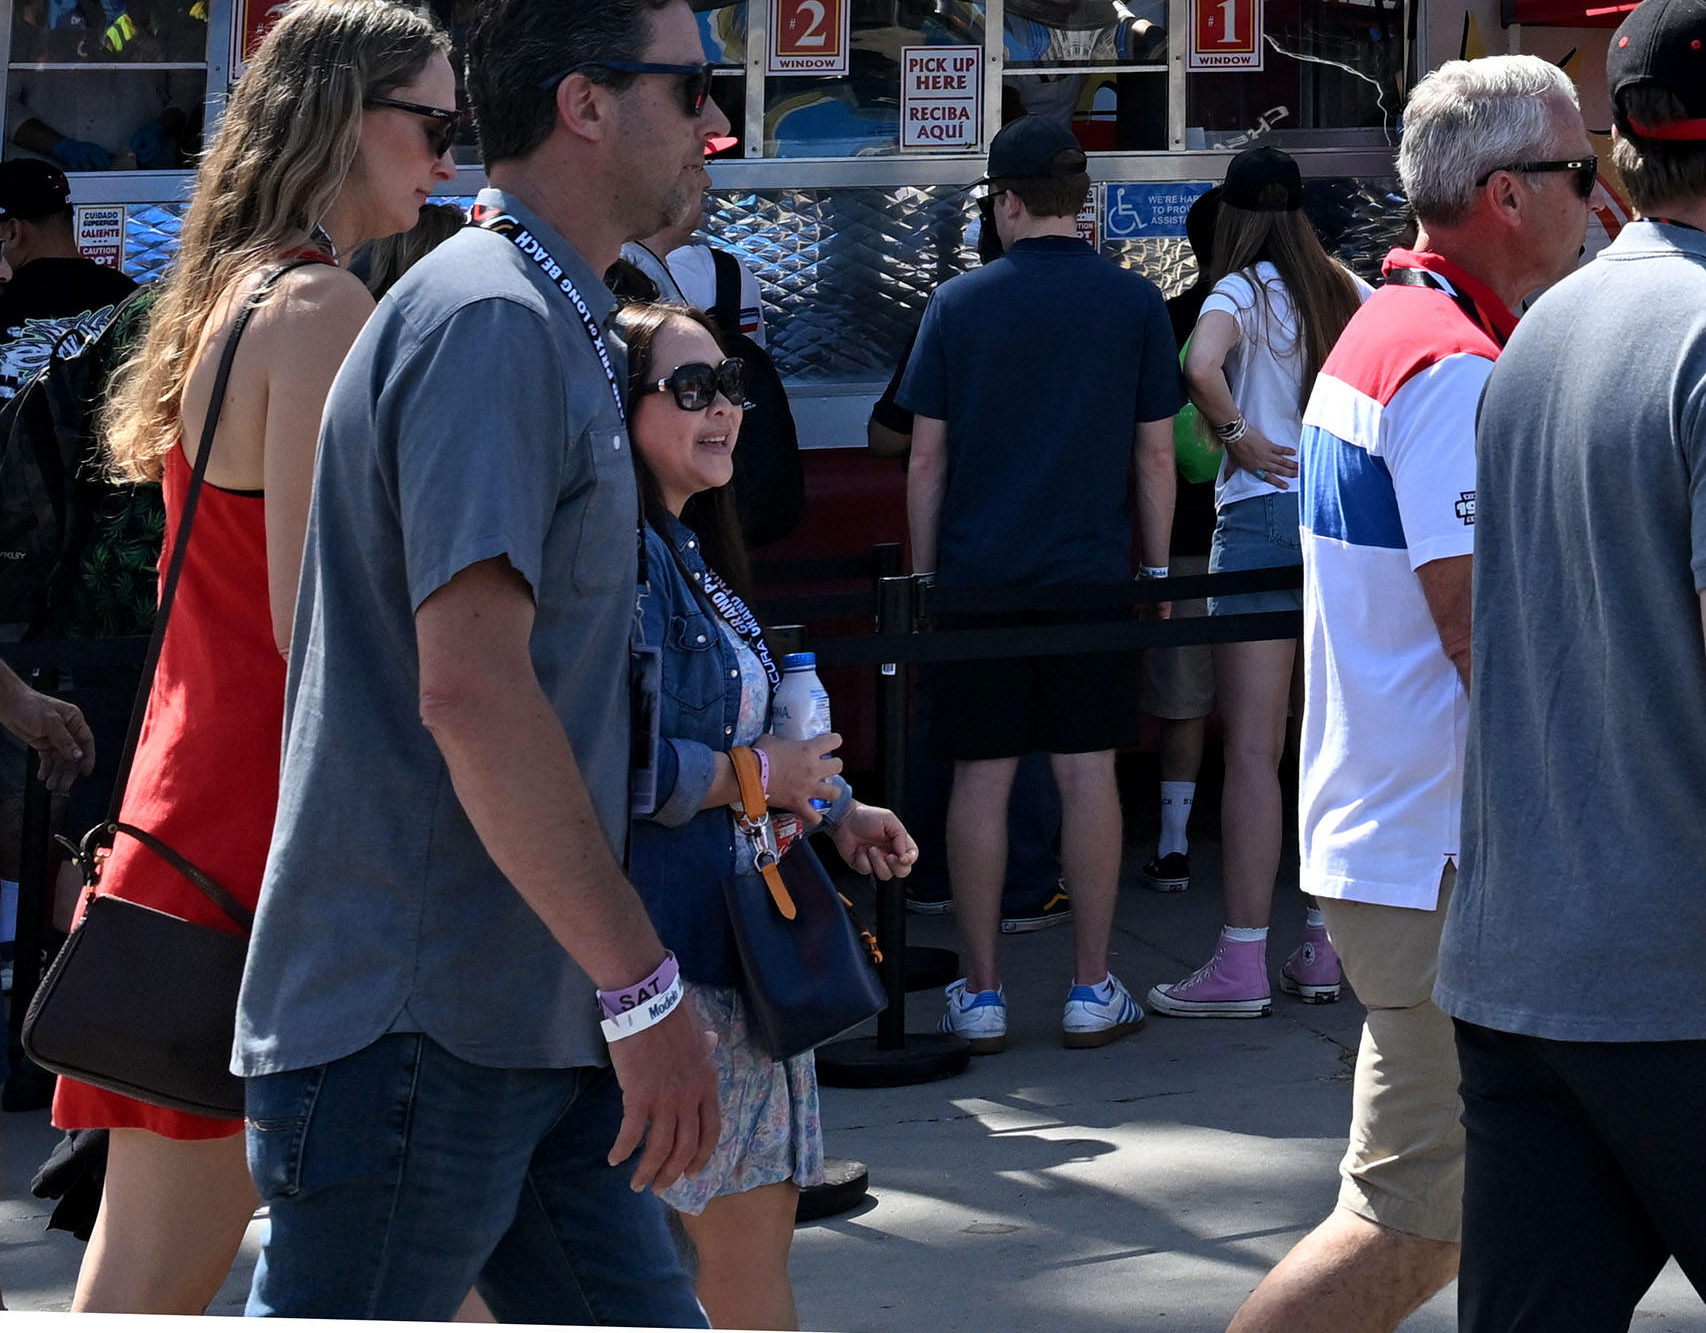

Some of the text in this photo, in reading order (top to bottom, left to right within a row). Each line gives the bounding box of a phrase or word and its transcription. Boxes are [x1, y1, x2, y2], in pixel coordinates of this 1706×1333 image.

[779, 59, 836, 68] WINDOW
[909, 57, 975, 73] PICK UP
[1198, 56, 1252, 65] WINDOW
[916, 75, 968, 90] HERE
[909, 106, 970, 121] RECIBA
[916, 121, 964, 141] AQUÍ
[1148, 194, 1201, 204] WE'RE HAP
[84, 211, 119, 220] CUIDADO
[1152, 205, 1191, 214] TO PRO
[1077, 222, 1093, 230] TION
[81, 228, 120, 238] CALIENTE
[83, 246, 117, 255] CAUTION
[514, 230, 563, 280] BEACH
[90, 255, 115, 265] OT
[560, 278, 592, 323] LONG
[712, 592, 749, 634] GRAND
[619, 976, 660, 1012] SAT
[648, 989, 679, 1021] Modelo
